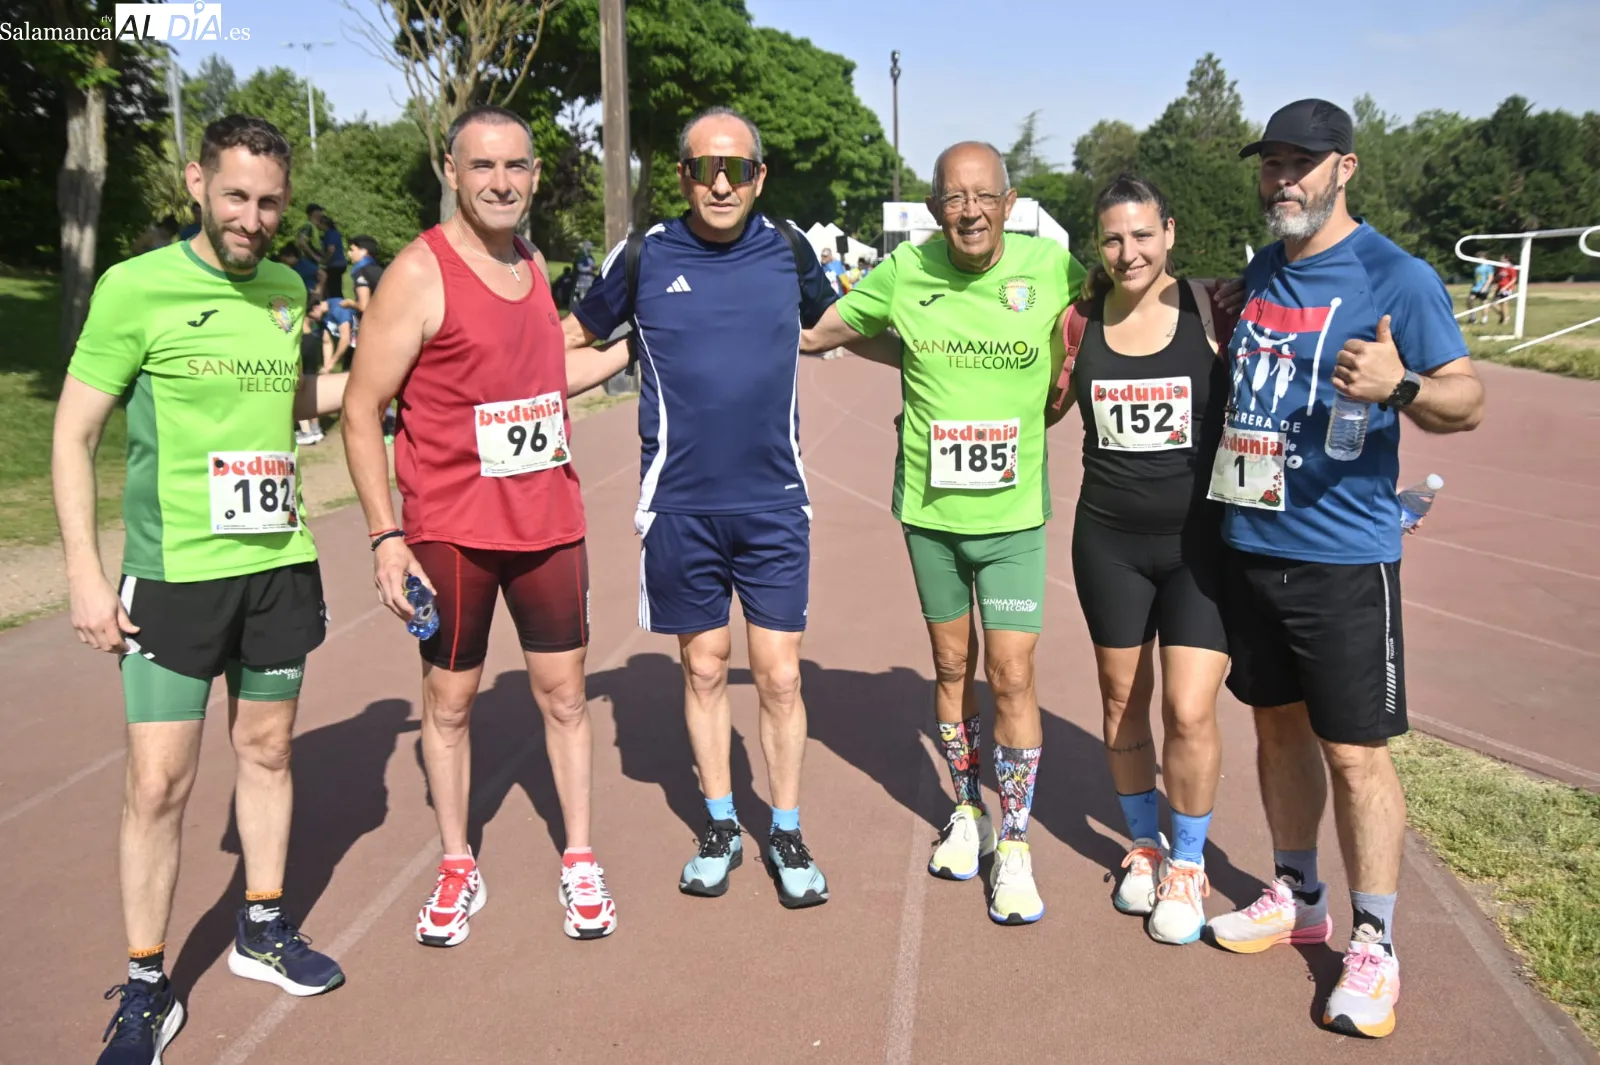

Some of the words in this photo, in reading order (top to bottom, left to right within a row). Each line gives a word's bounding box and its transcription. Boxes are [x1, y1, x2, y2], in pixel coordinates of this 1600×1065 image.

[912, 339, 1028, 356] SANMAXIMO
[946, 355, 1019, 370] TELECOM
[1094, 382, 1188, 402] bedunia
[1109, 402, 1175, 434] 152
[507, 421, 548, 457] 96
[933, 425, 1018, 442] bedunia
[949, 443, 1008, 472] 185
[1234, 454, 1245, 487] 1
[234, 478, 291, 514] 182
